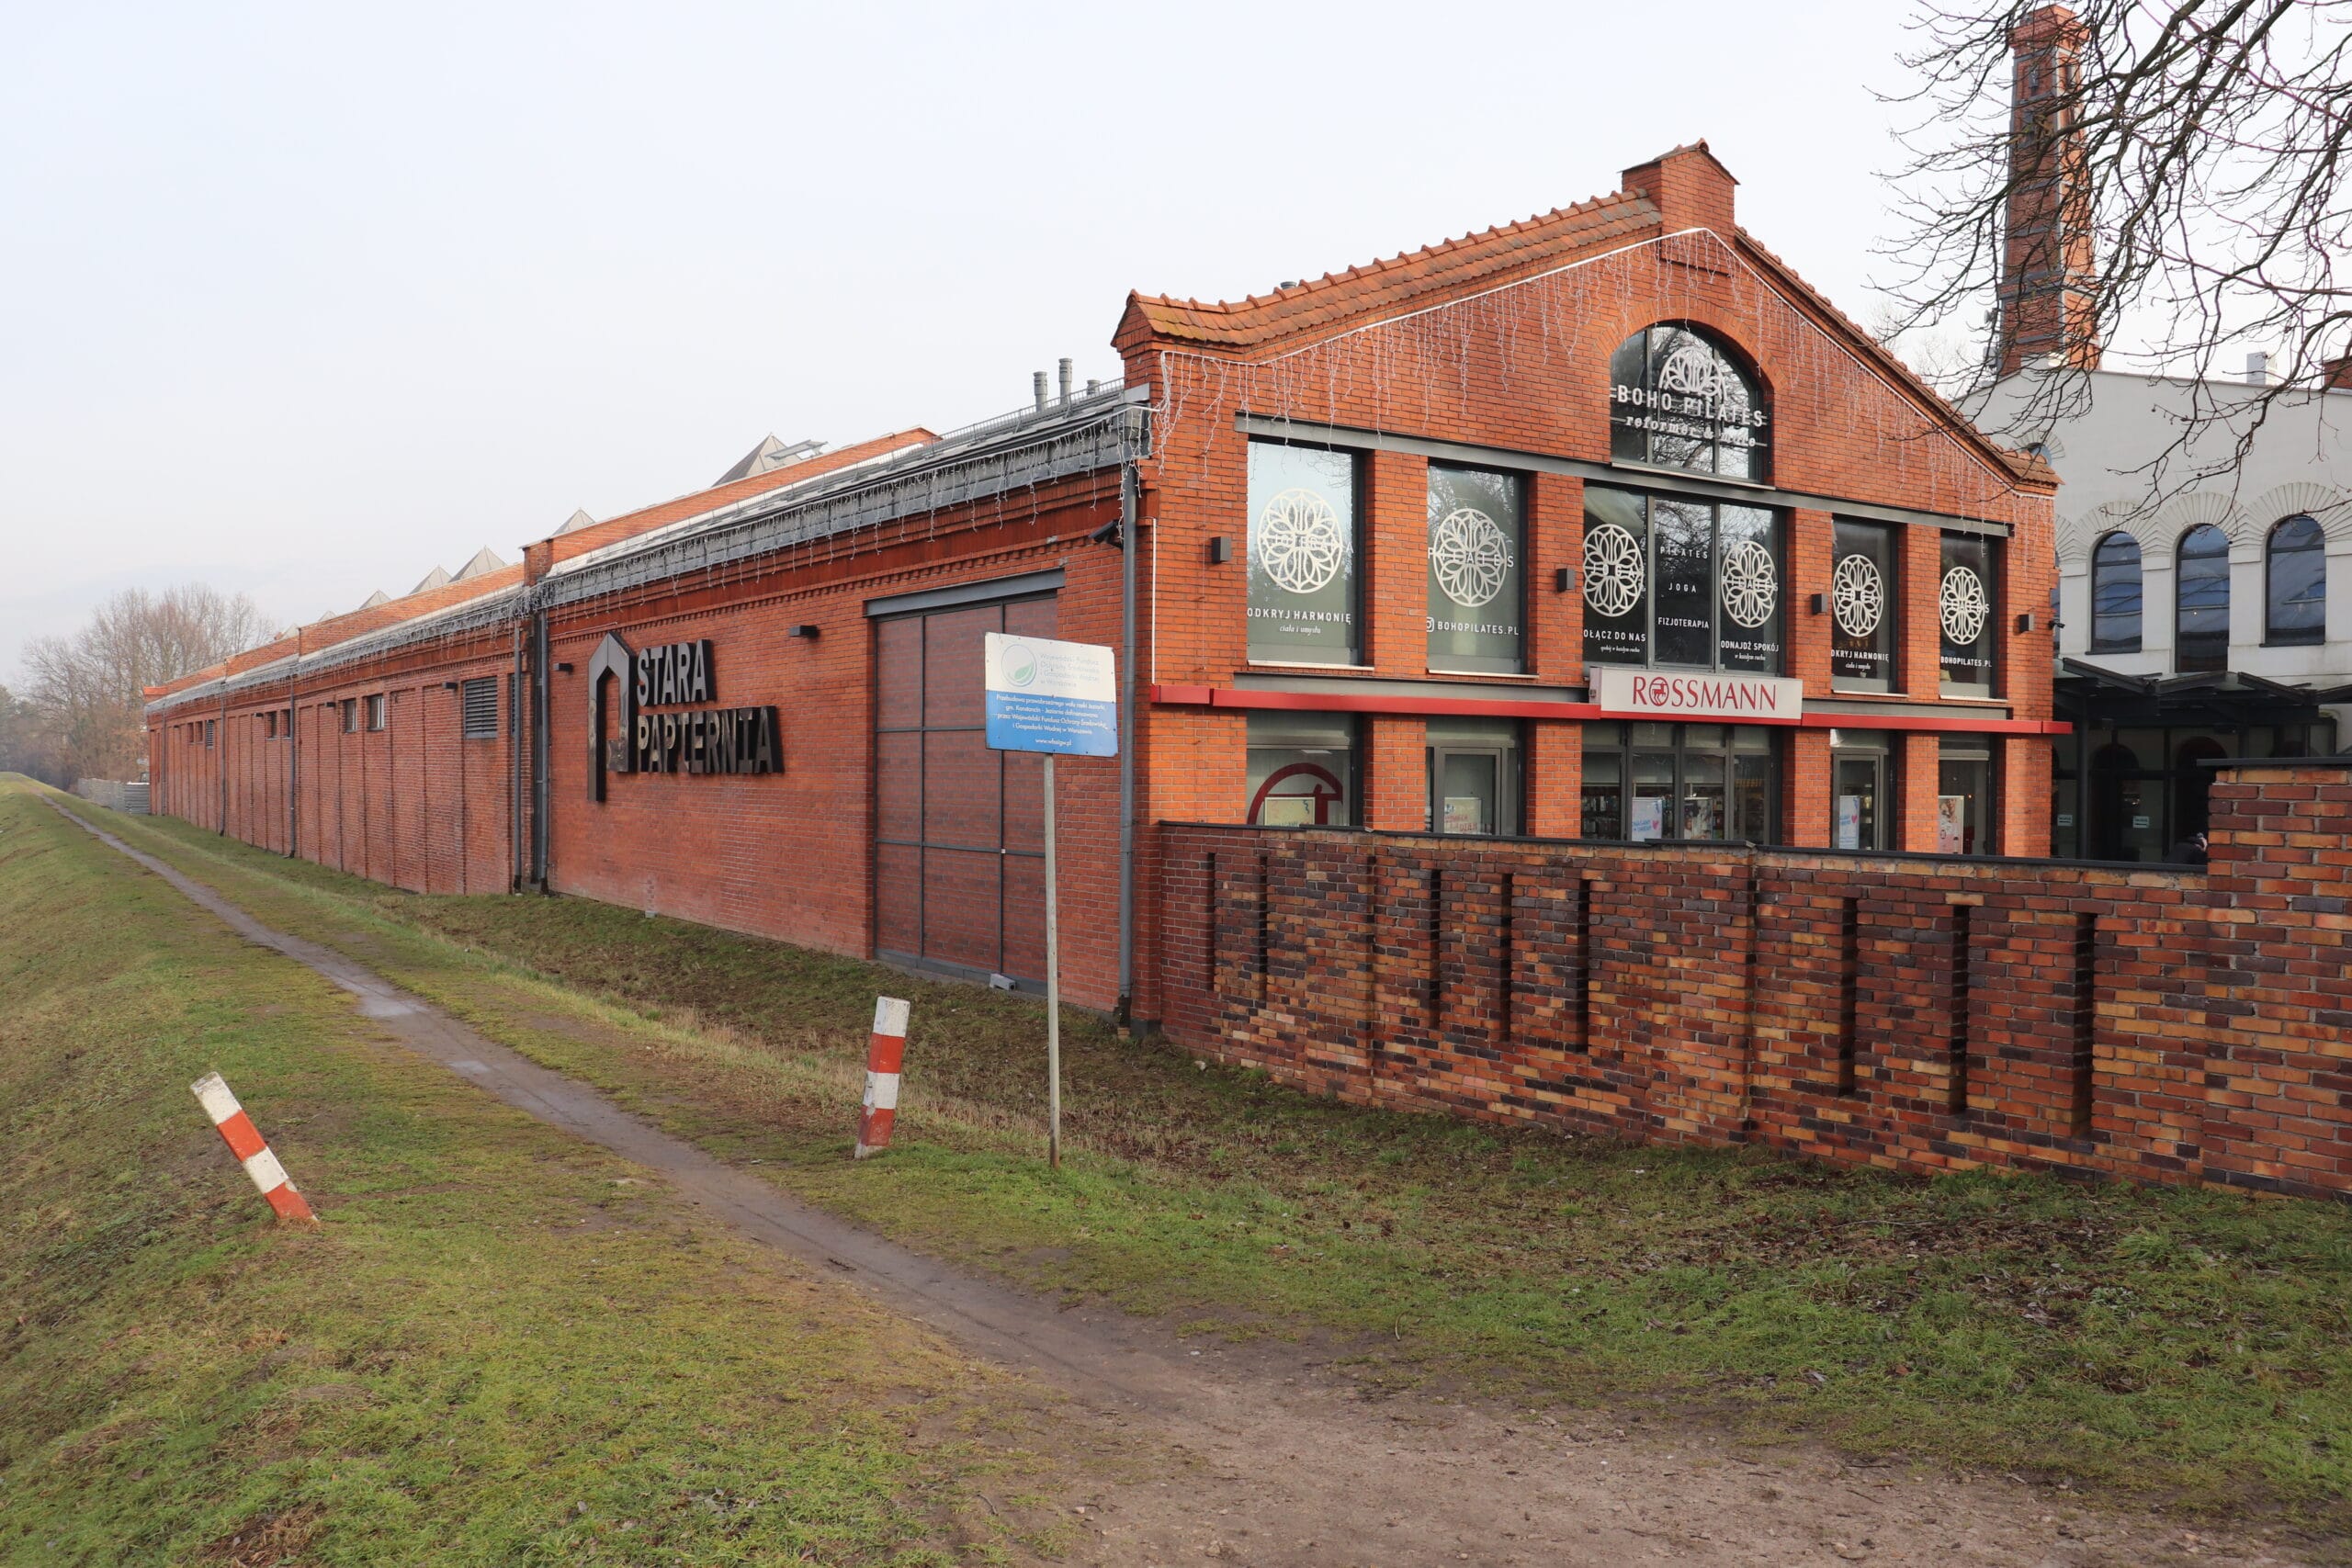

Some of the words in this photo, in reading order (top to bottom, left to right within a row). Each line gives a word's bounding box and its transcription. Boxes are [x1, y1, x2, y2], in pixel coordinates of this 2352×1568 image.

[1617, 384, 1672, 411] BOHO
[1684, 397, 1763, 427] PILATES
[1625, 415, 1696, 436] reformer
[1702, 426, 1714, 440] &
[1659, 546, 1708, 559] PILATES
[1668, 582, 1697, 593] JOGA
[1247, 607, 1291, 619] ODKRYJ
[1294, 610, 1351, 626] HARMONIĘ
[1657, 616, 1710, 630] FIZJOTERAPIA
[1437, 621, 1520, 636] BOHOPILATES.PL
[1583, 628, 1612, 641] OŁĄCZ
[1614, 631, 1626, 640] DO
[1628, 632, 1646, 642] NAS
[1720, 640, 1752, 650] ODNAJDŹ
[1753, 642, 1780, 652] SPOKÓJ
[1830, 649, 1853, 659] DKRYJ
[1853, 650, 1890, 663] HARMONIĘ
[1940, 656, 1993, 668] BOHOPILATES.PL
[637, 638, 712, 707] STARA
[1632, 675, 1777, 711] ROSSMANN
[637, 705, 777, 773] PAPIERNIA
